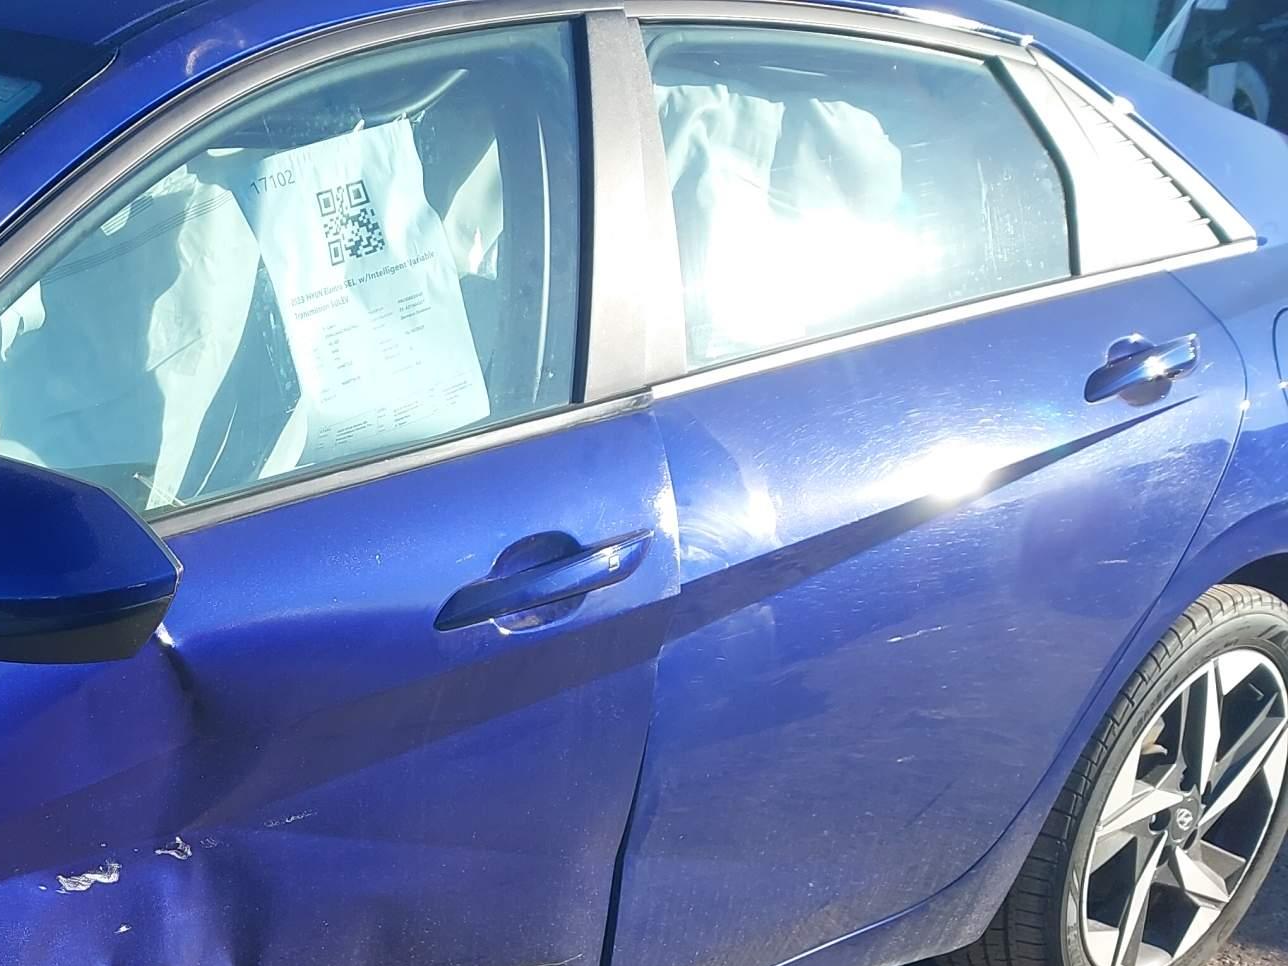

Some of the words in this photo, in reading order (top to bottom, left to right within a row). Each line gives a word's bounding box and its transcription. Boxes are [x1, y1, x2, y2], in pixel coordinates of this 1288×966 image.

[250, 169, 296, 195] 17102
[344, 278, 357, 289] SEL
[358, 259, 407, 285] w/Intelligent
